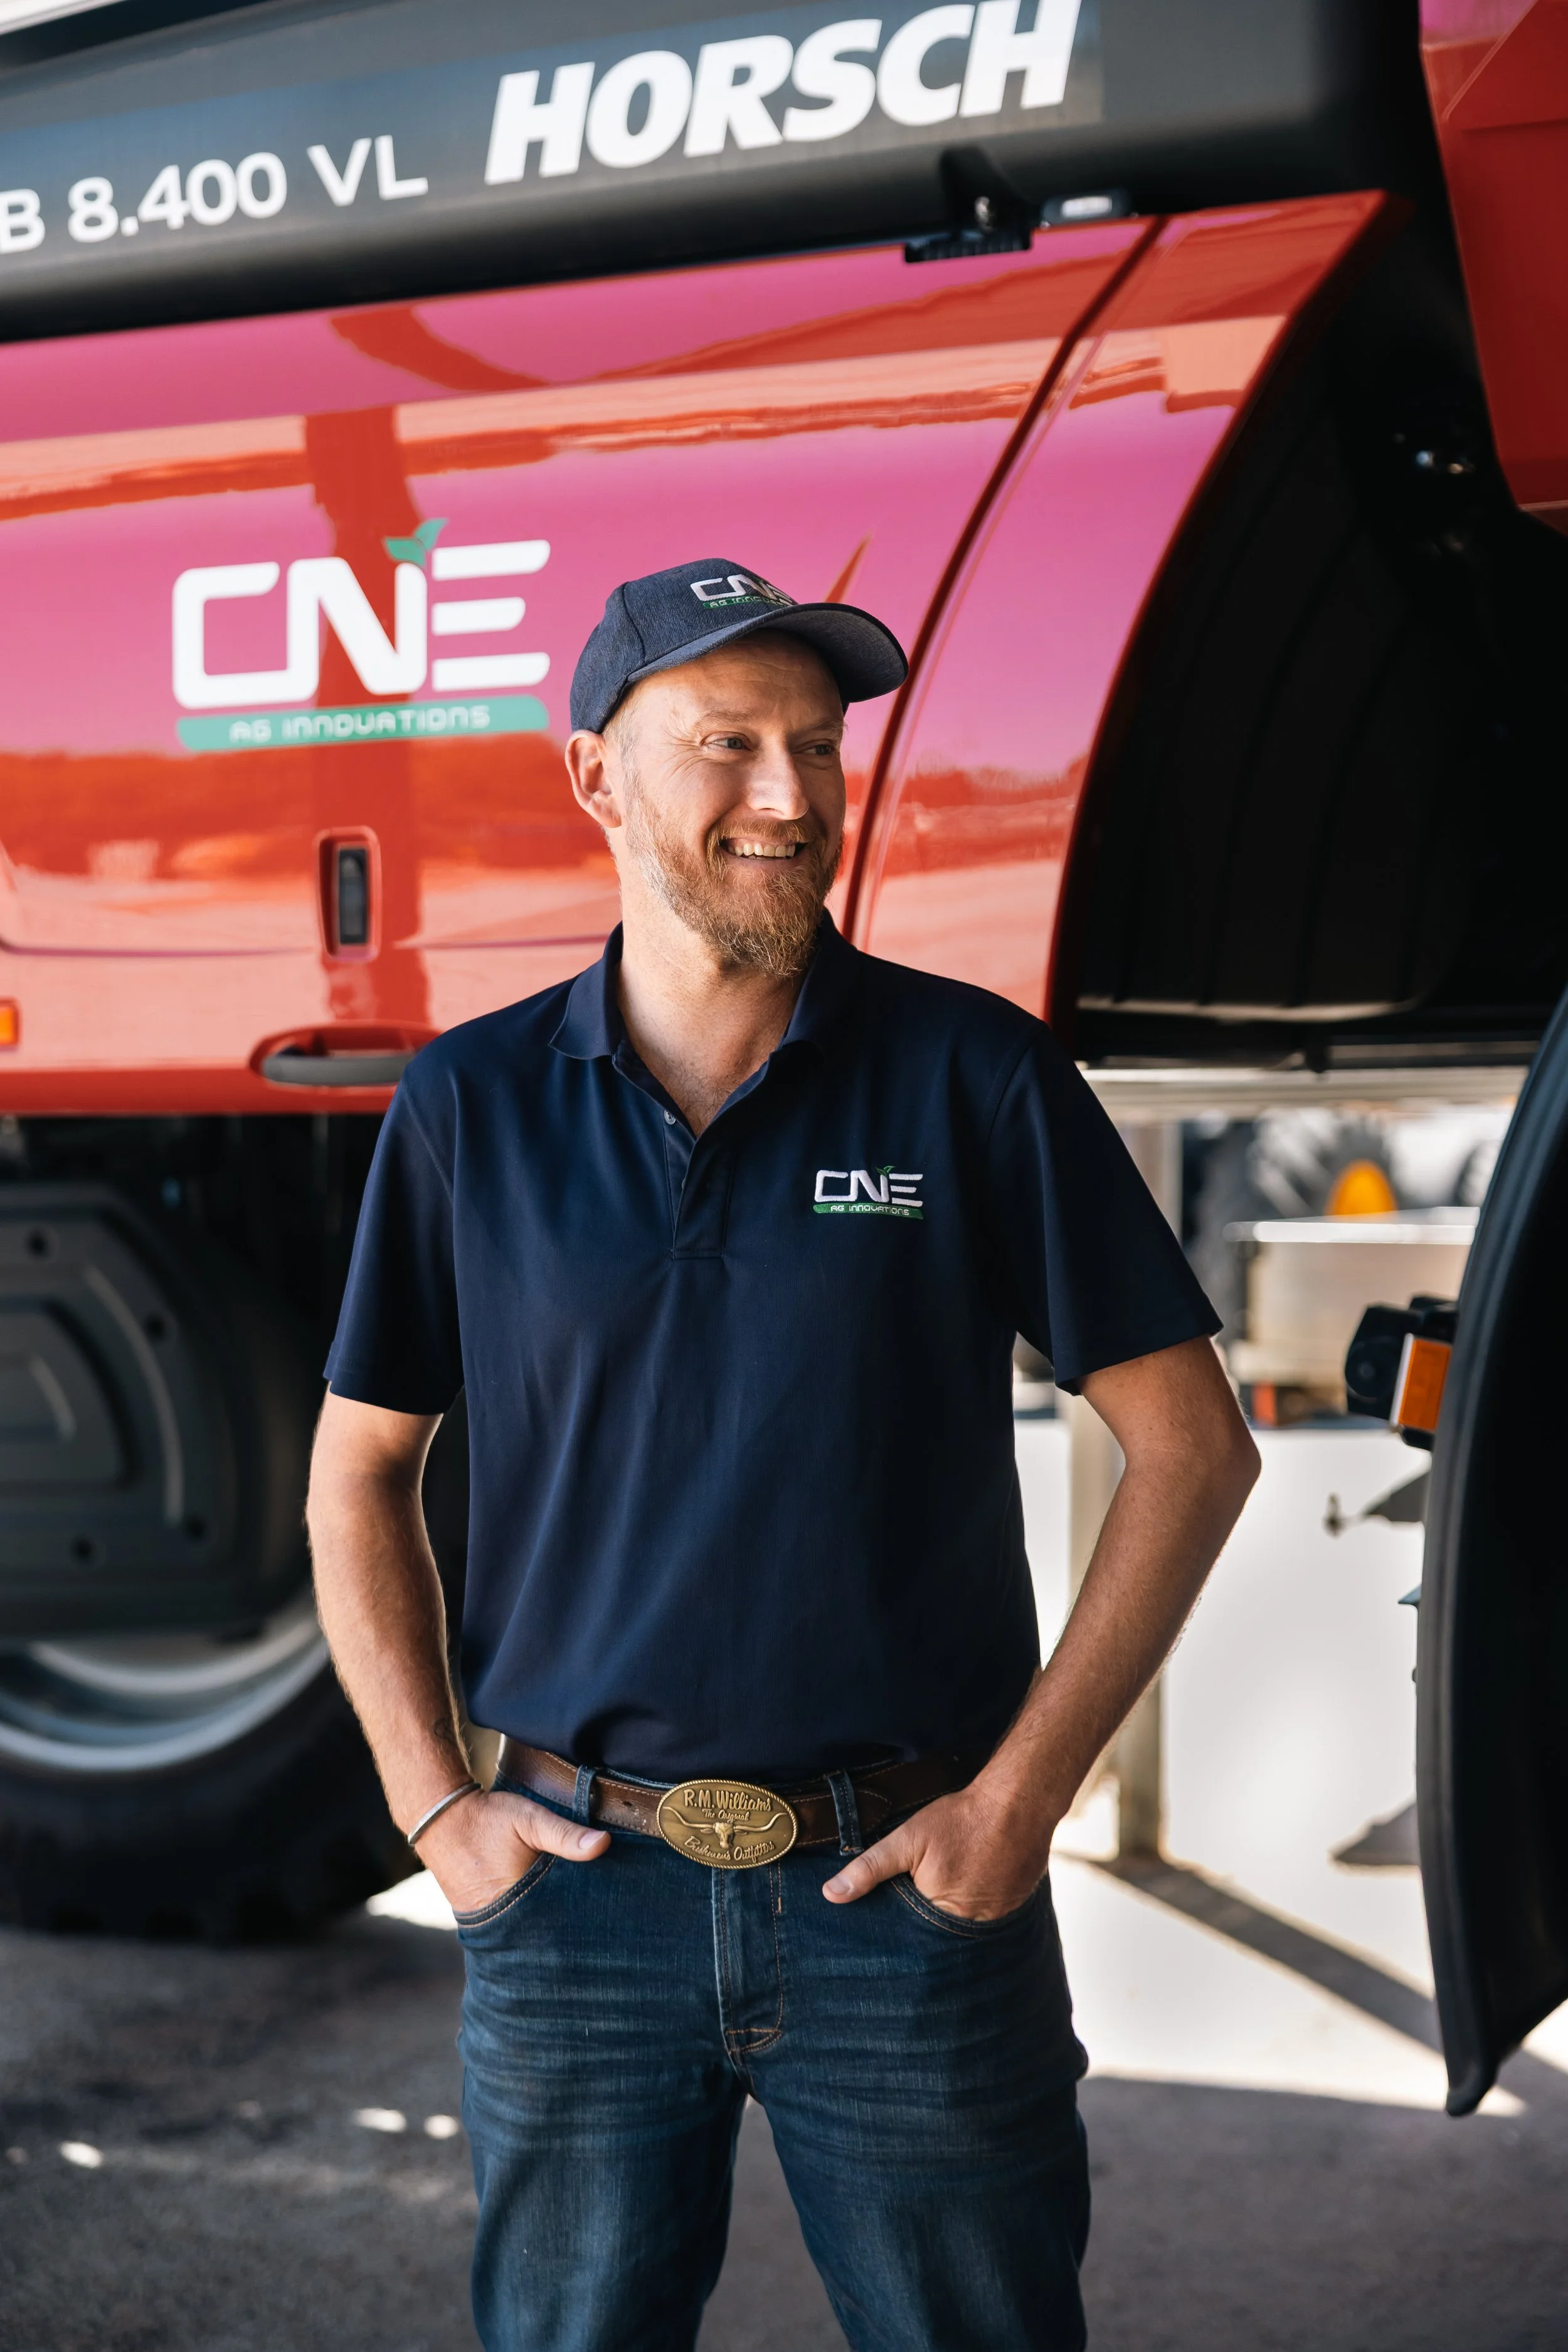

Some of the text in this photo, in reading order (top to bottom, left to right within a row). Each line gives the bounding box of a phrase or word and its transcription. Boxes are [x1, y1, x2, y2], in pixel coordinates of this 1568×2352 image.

[484, 0, 1082, 186] HORSCH
[68, 152, 288, 243] 8.400
[307, 134, 430, 207] VL
[710, 600, 727, 608] AG
[172, 539, 551, 710] CNE
[230, 719, 272, 743] AG
[815, 1170, 923, 1207] CNE
[702, 1808, 750, 1823] The Original
